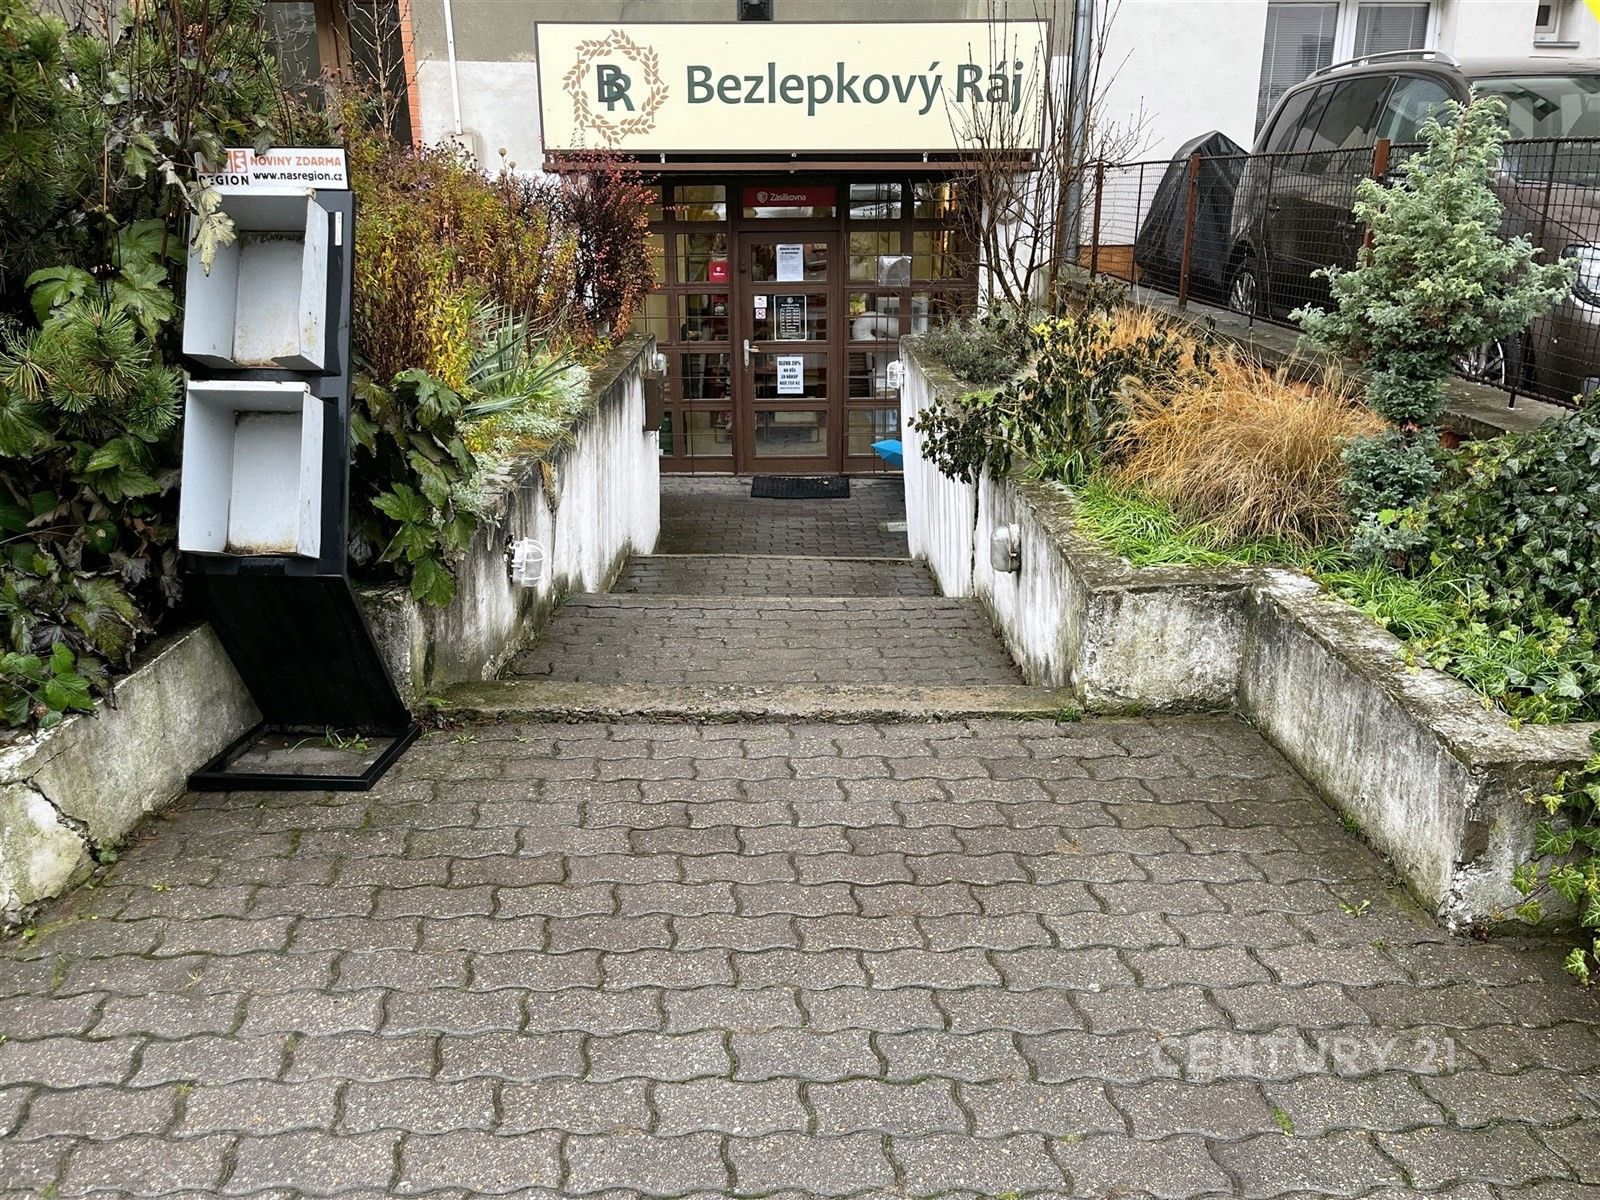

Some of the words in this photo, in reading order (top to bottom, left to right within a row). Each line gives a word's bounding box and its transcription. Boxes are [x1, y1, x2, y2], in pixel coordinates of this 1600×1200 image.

[686, 61, 943, 116] Bezlepkový
[956, 61, 1024, 114] Ráj
[250, 156, 292, 166] NOVINY
[296, 156, 342, 167] ZDARMA
[253, 171, 343, 182] www.nasregion.cz
[769, 192, 807, 202] Zásilkovna
